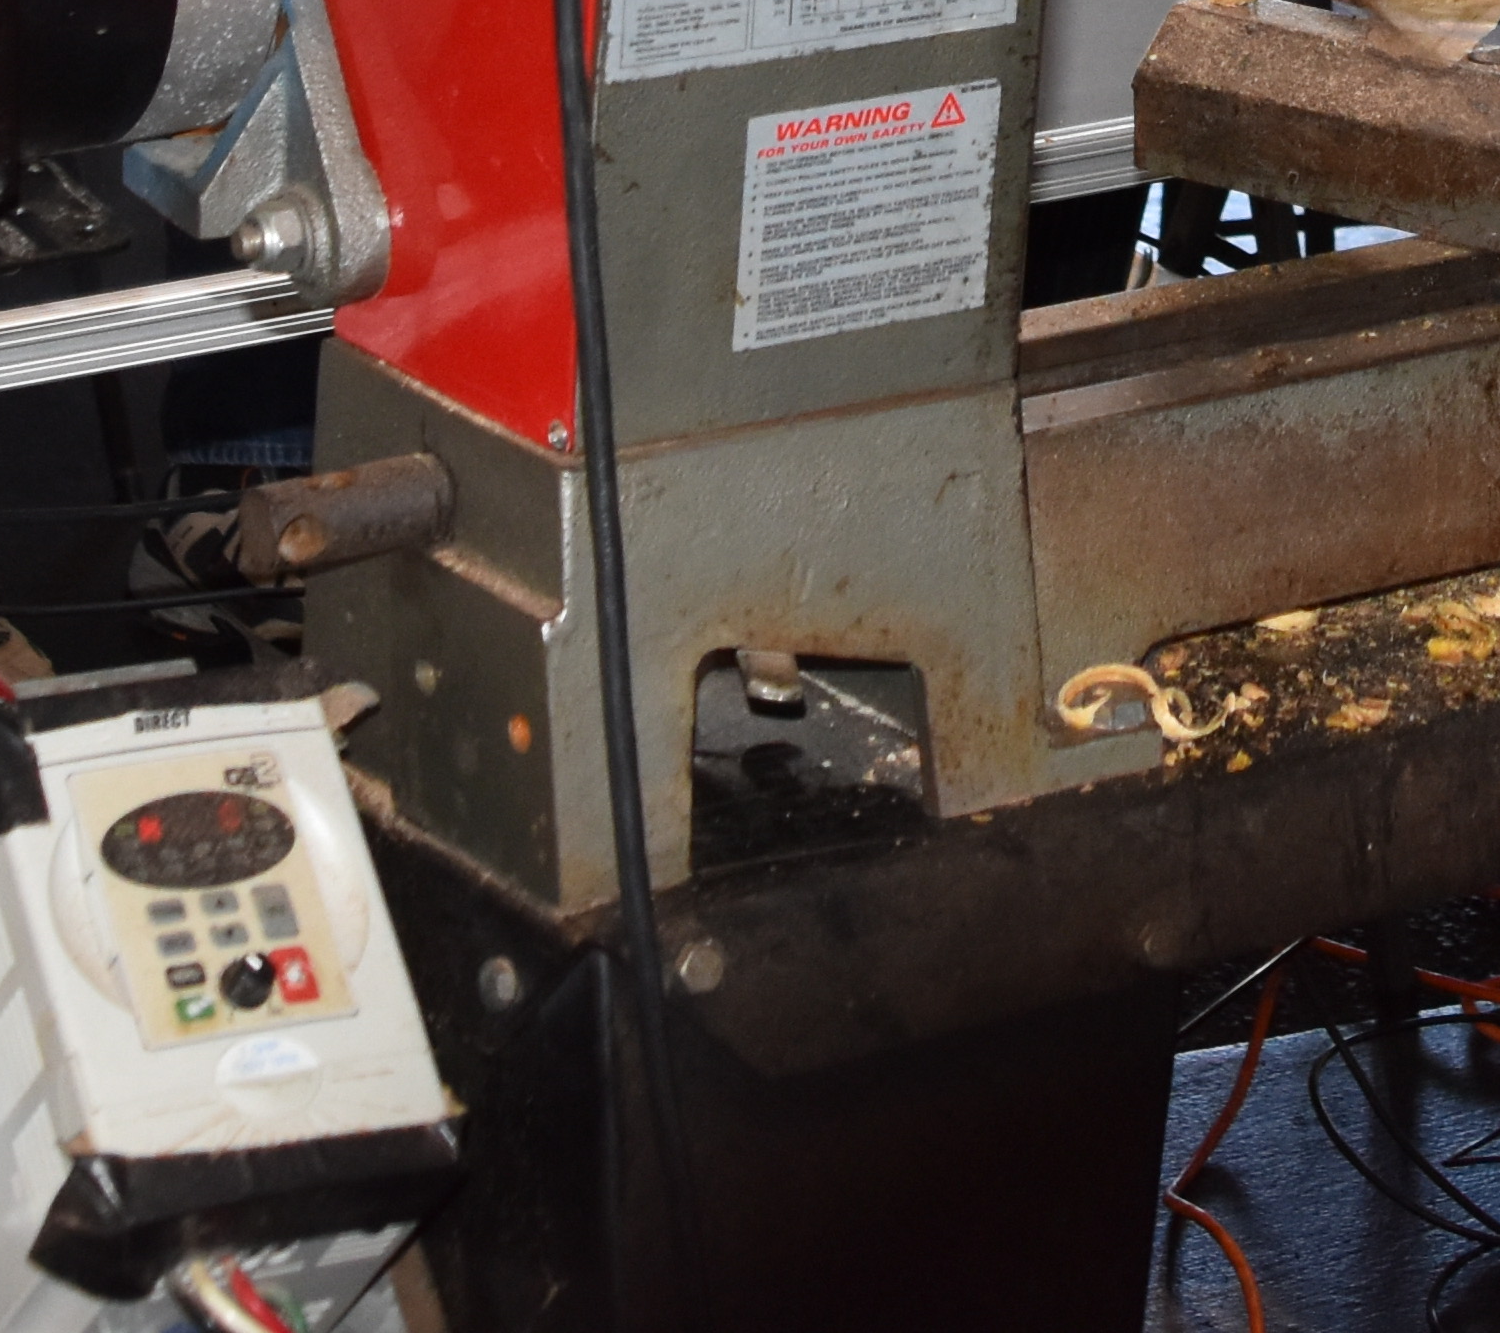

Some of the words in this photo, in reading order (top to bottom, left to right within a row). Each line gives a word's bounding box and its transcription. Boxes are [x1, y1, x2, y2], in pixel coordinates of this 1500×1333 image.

[756, 146, 786, 160] FOR
[791, 139, 829, 154] YOUR
[834, 132, 868, 147] OWN
[871, 121, 927, 140] SAFETY
[775, 101, 913, 143] WARNING
[134, 708, 191, 734] DIRECT
